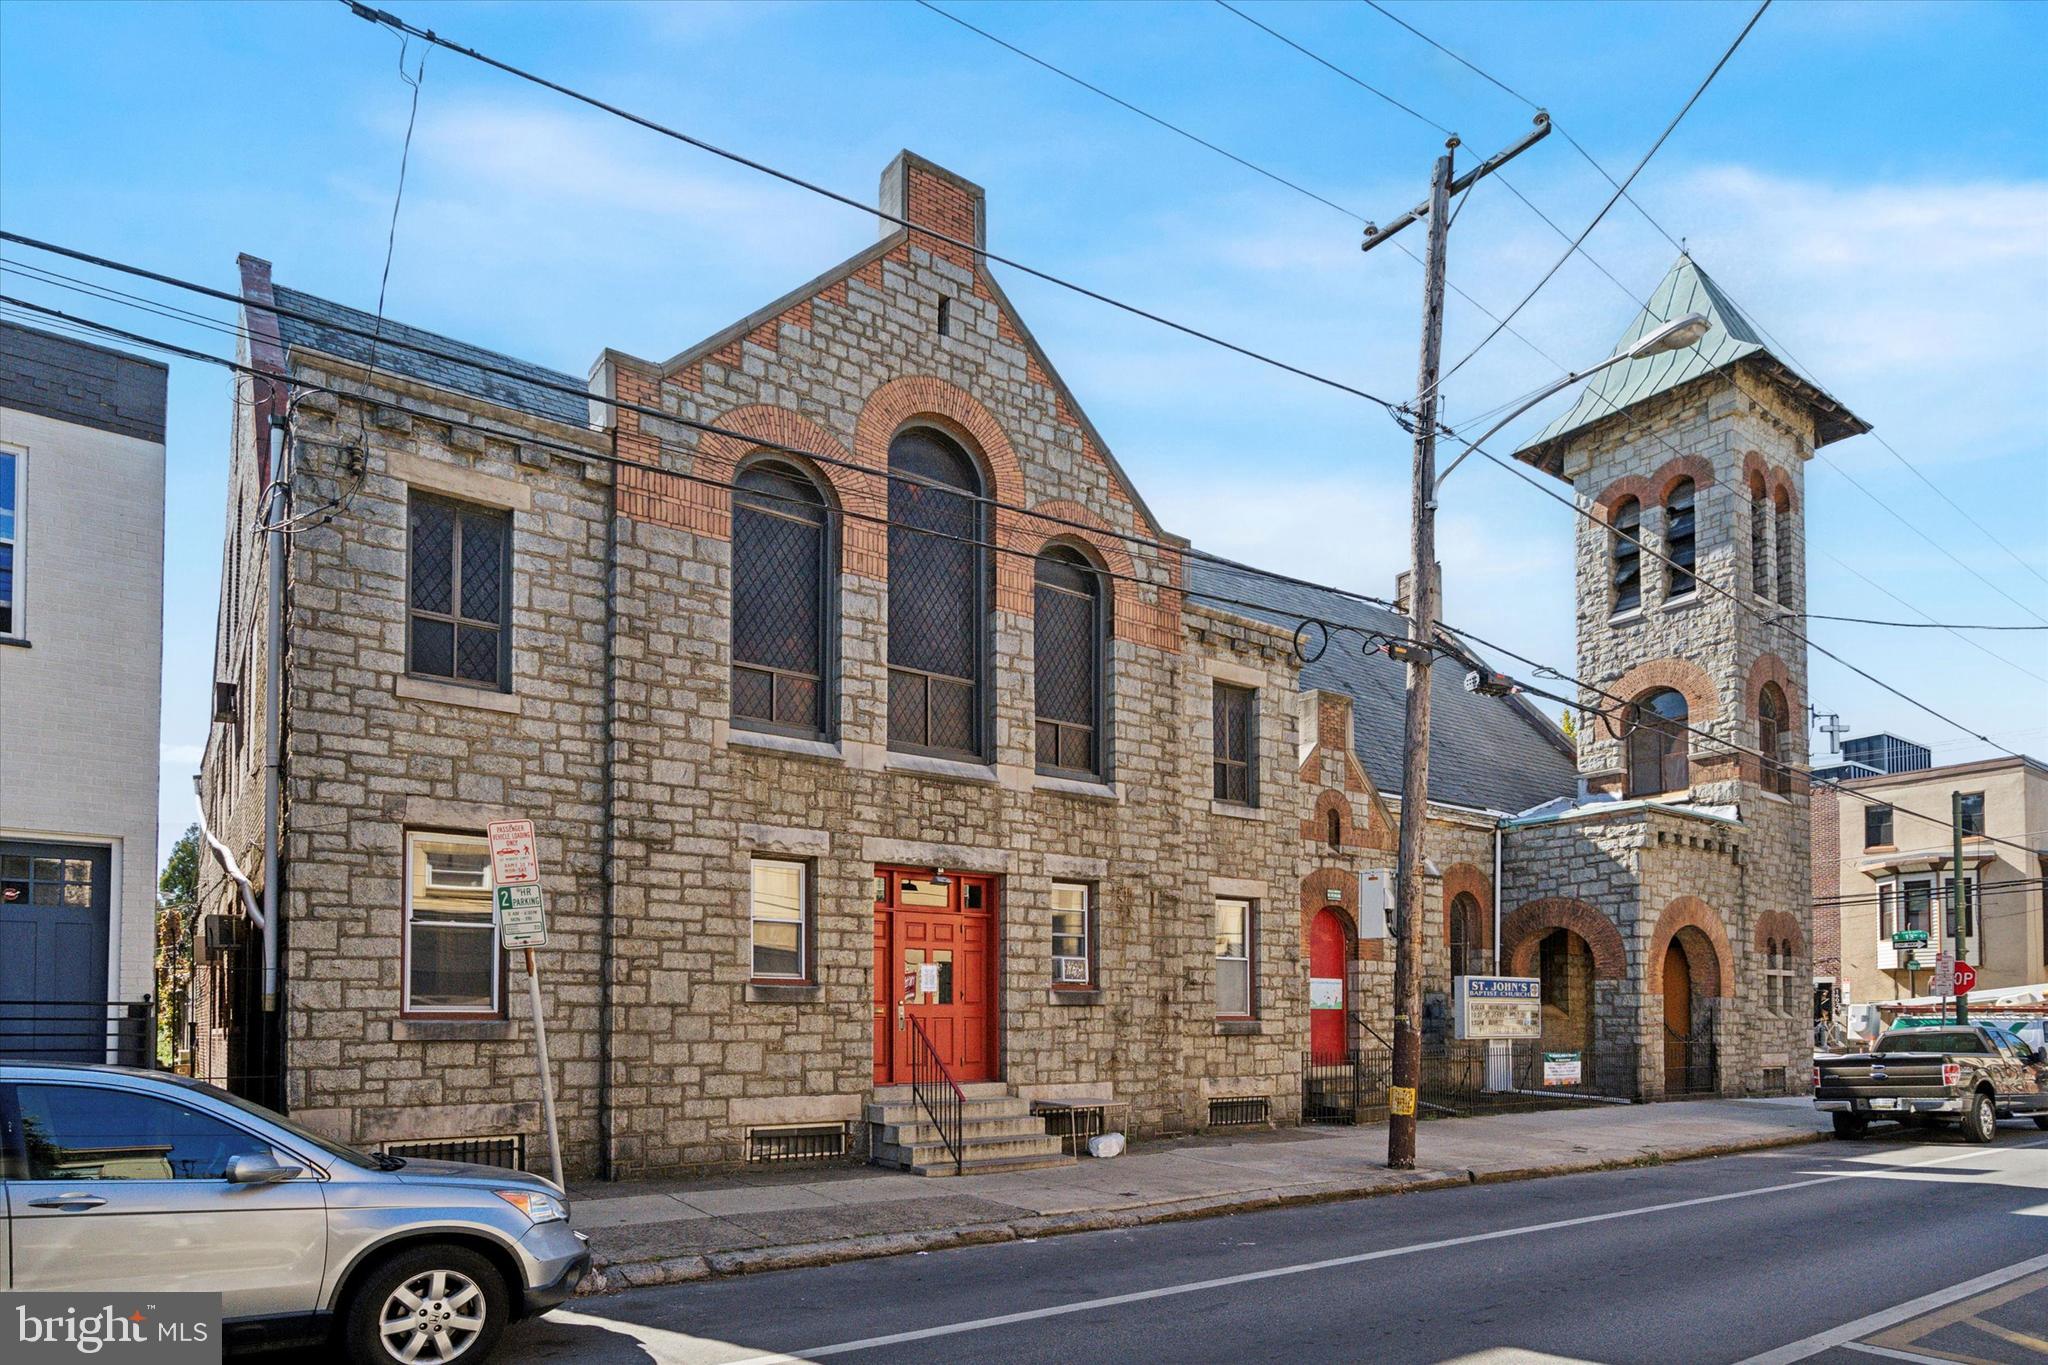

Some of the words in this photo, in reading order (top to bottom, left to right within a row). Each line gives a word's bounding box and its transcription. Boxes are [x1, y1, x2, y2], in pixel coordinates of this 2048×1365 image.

[496, 824, 524, 833] PASSENGER
[493, 833, 510, 841] VEHICLE
[520, 887, 532, 896] HR
[500, 890, 510, 907] 2
[512, 896, 540, 906] PARKING
[1954, 972, 1973, 985] OP
[1471, 981, 1489, 991] ST.
[1491, 981, 1528, 992] JOHN'S
